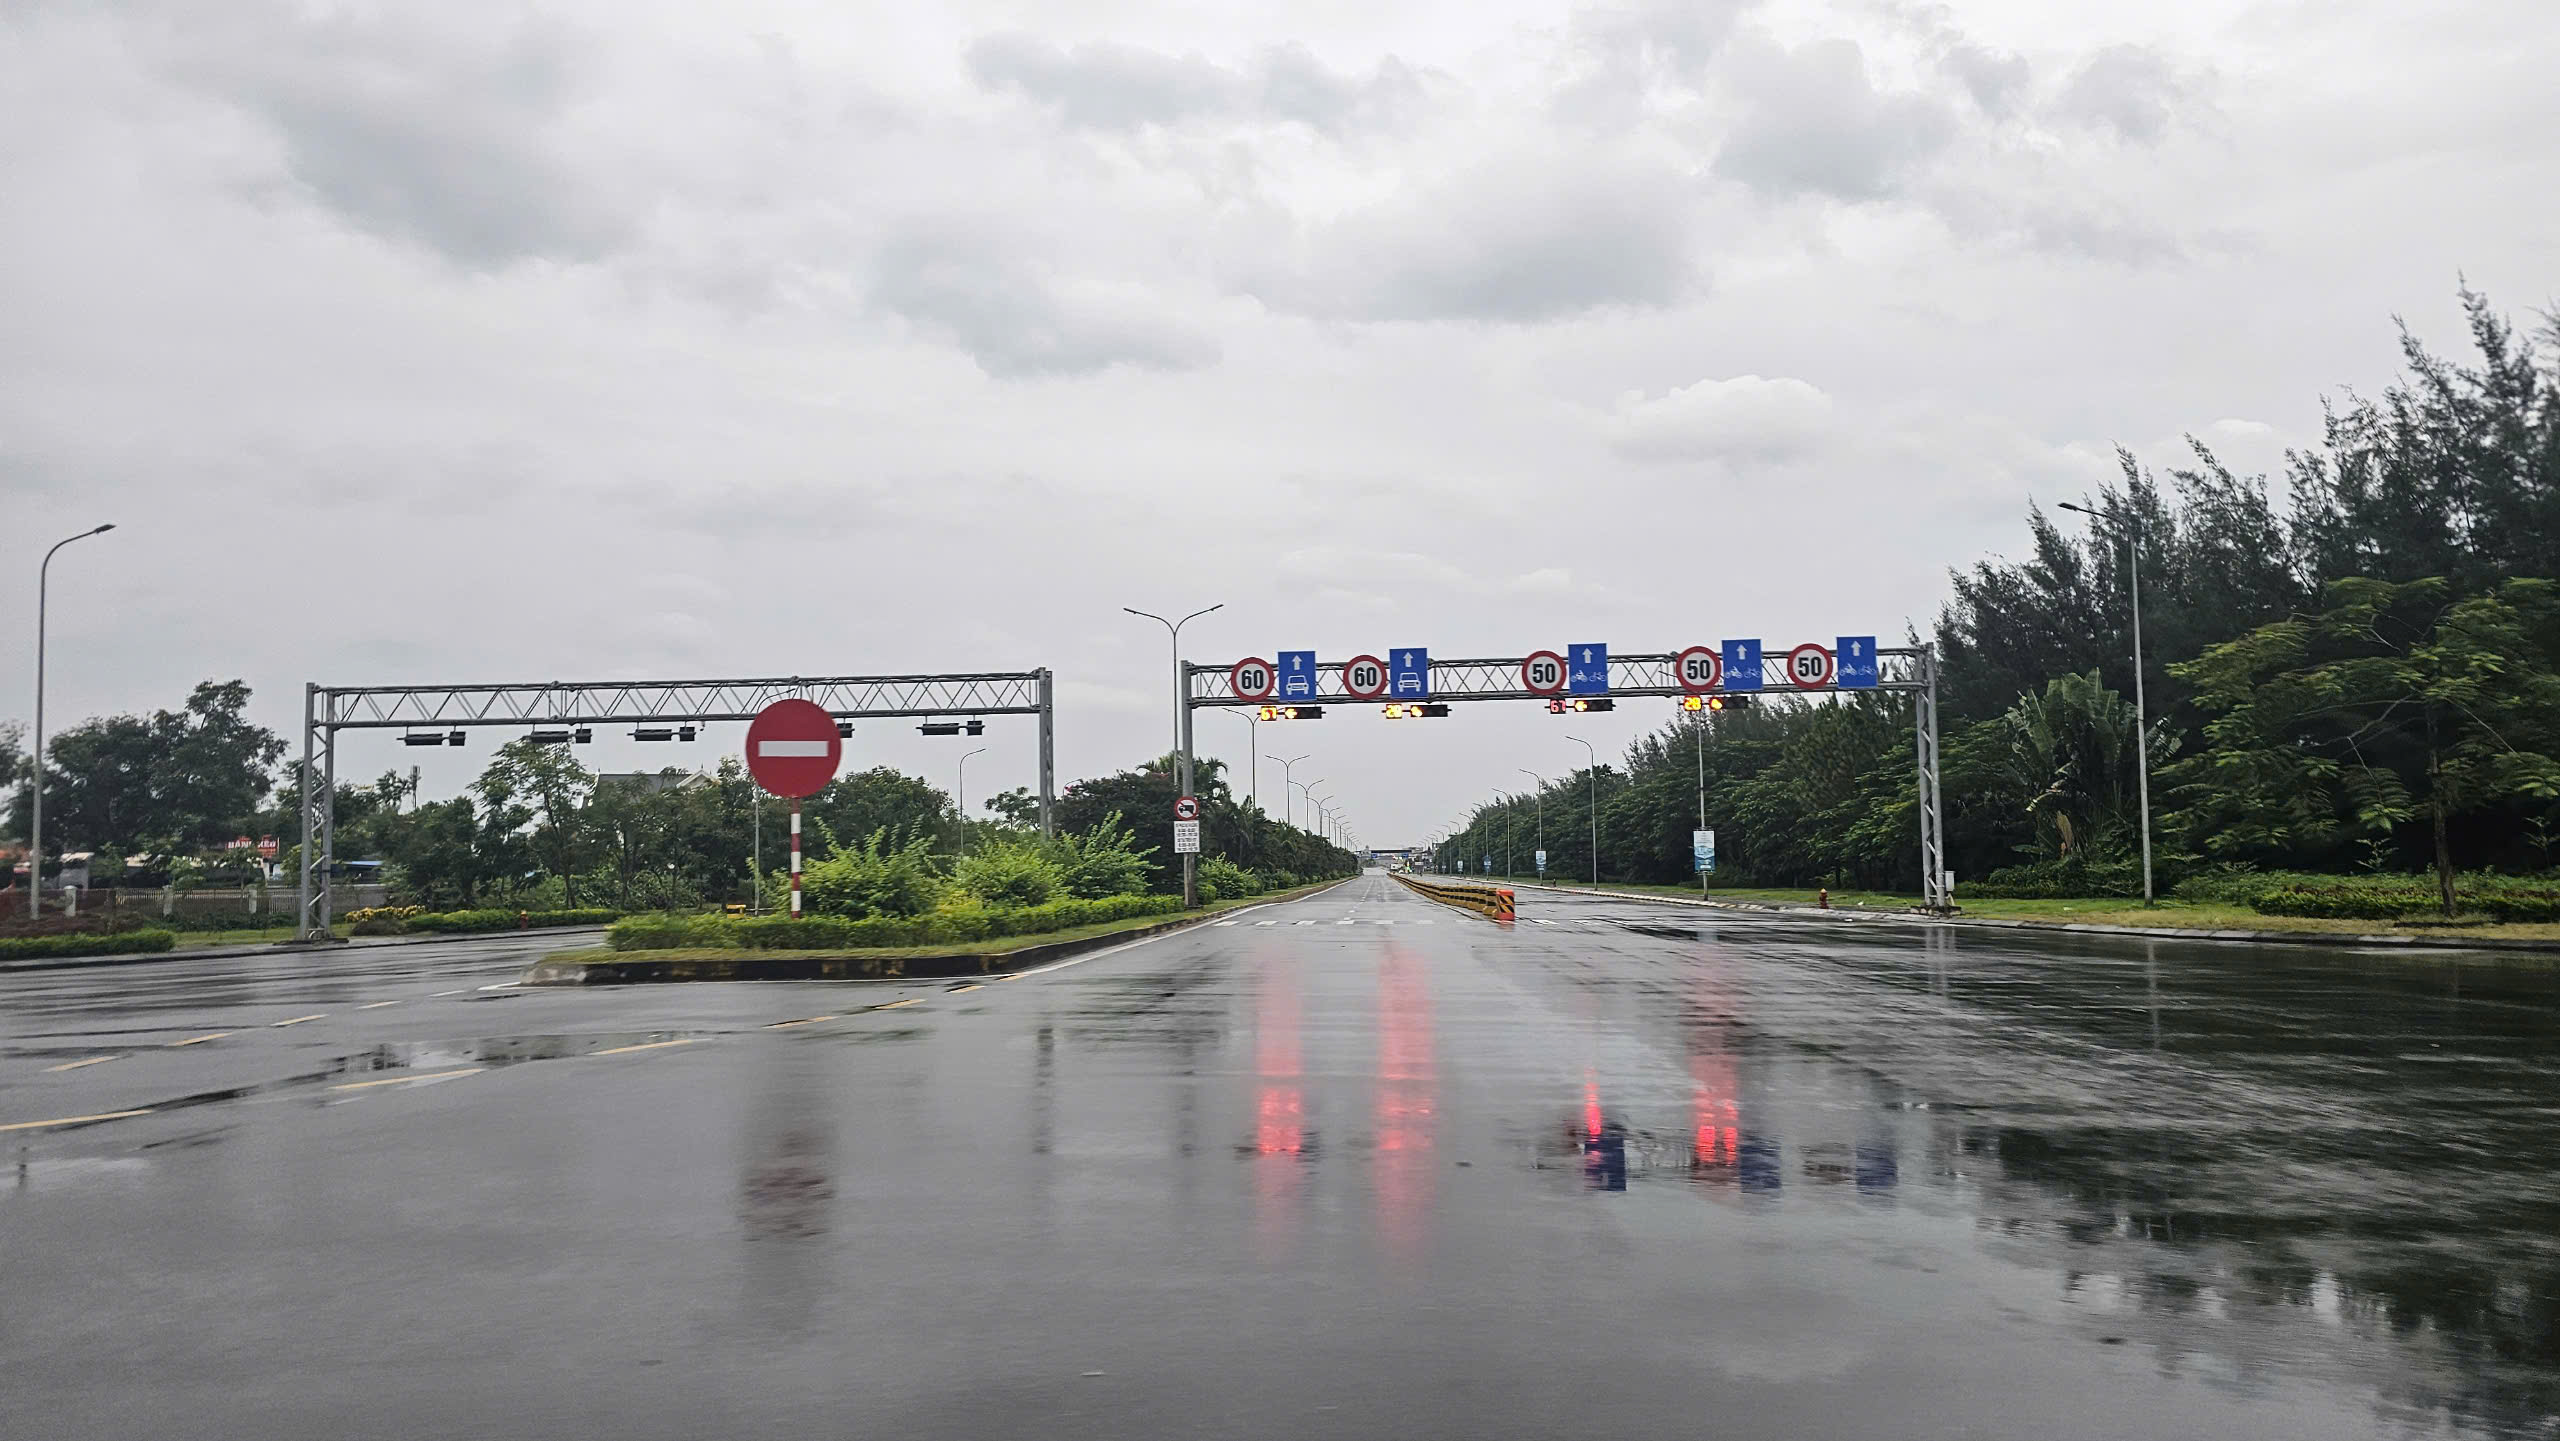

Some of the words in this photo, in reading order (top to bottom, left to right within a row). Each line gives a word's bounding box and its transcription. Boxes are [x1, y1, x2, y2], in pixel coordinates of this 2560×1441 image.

[1532, 663, 1556, 684] 50
[1686, 659, 1710, 680] 50
[1798, 656, 1822, 677] 50
[1241, 670, 1264, 690] 60
[1354, 667, 1377, 687] 60
[1551, 700, 1566, 713] 67
[1684, 697, 1702, 711] 28
